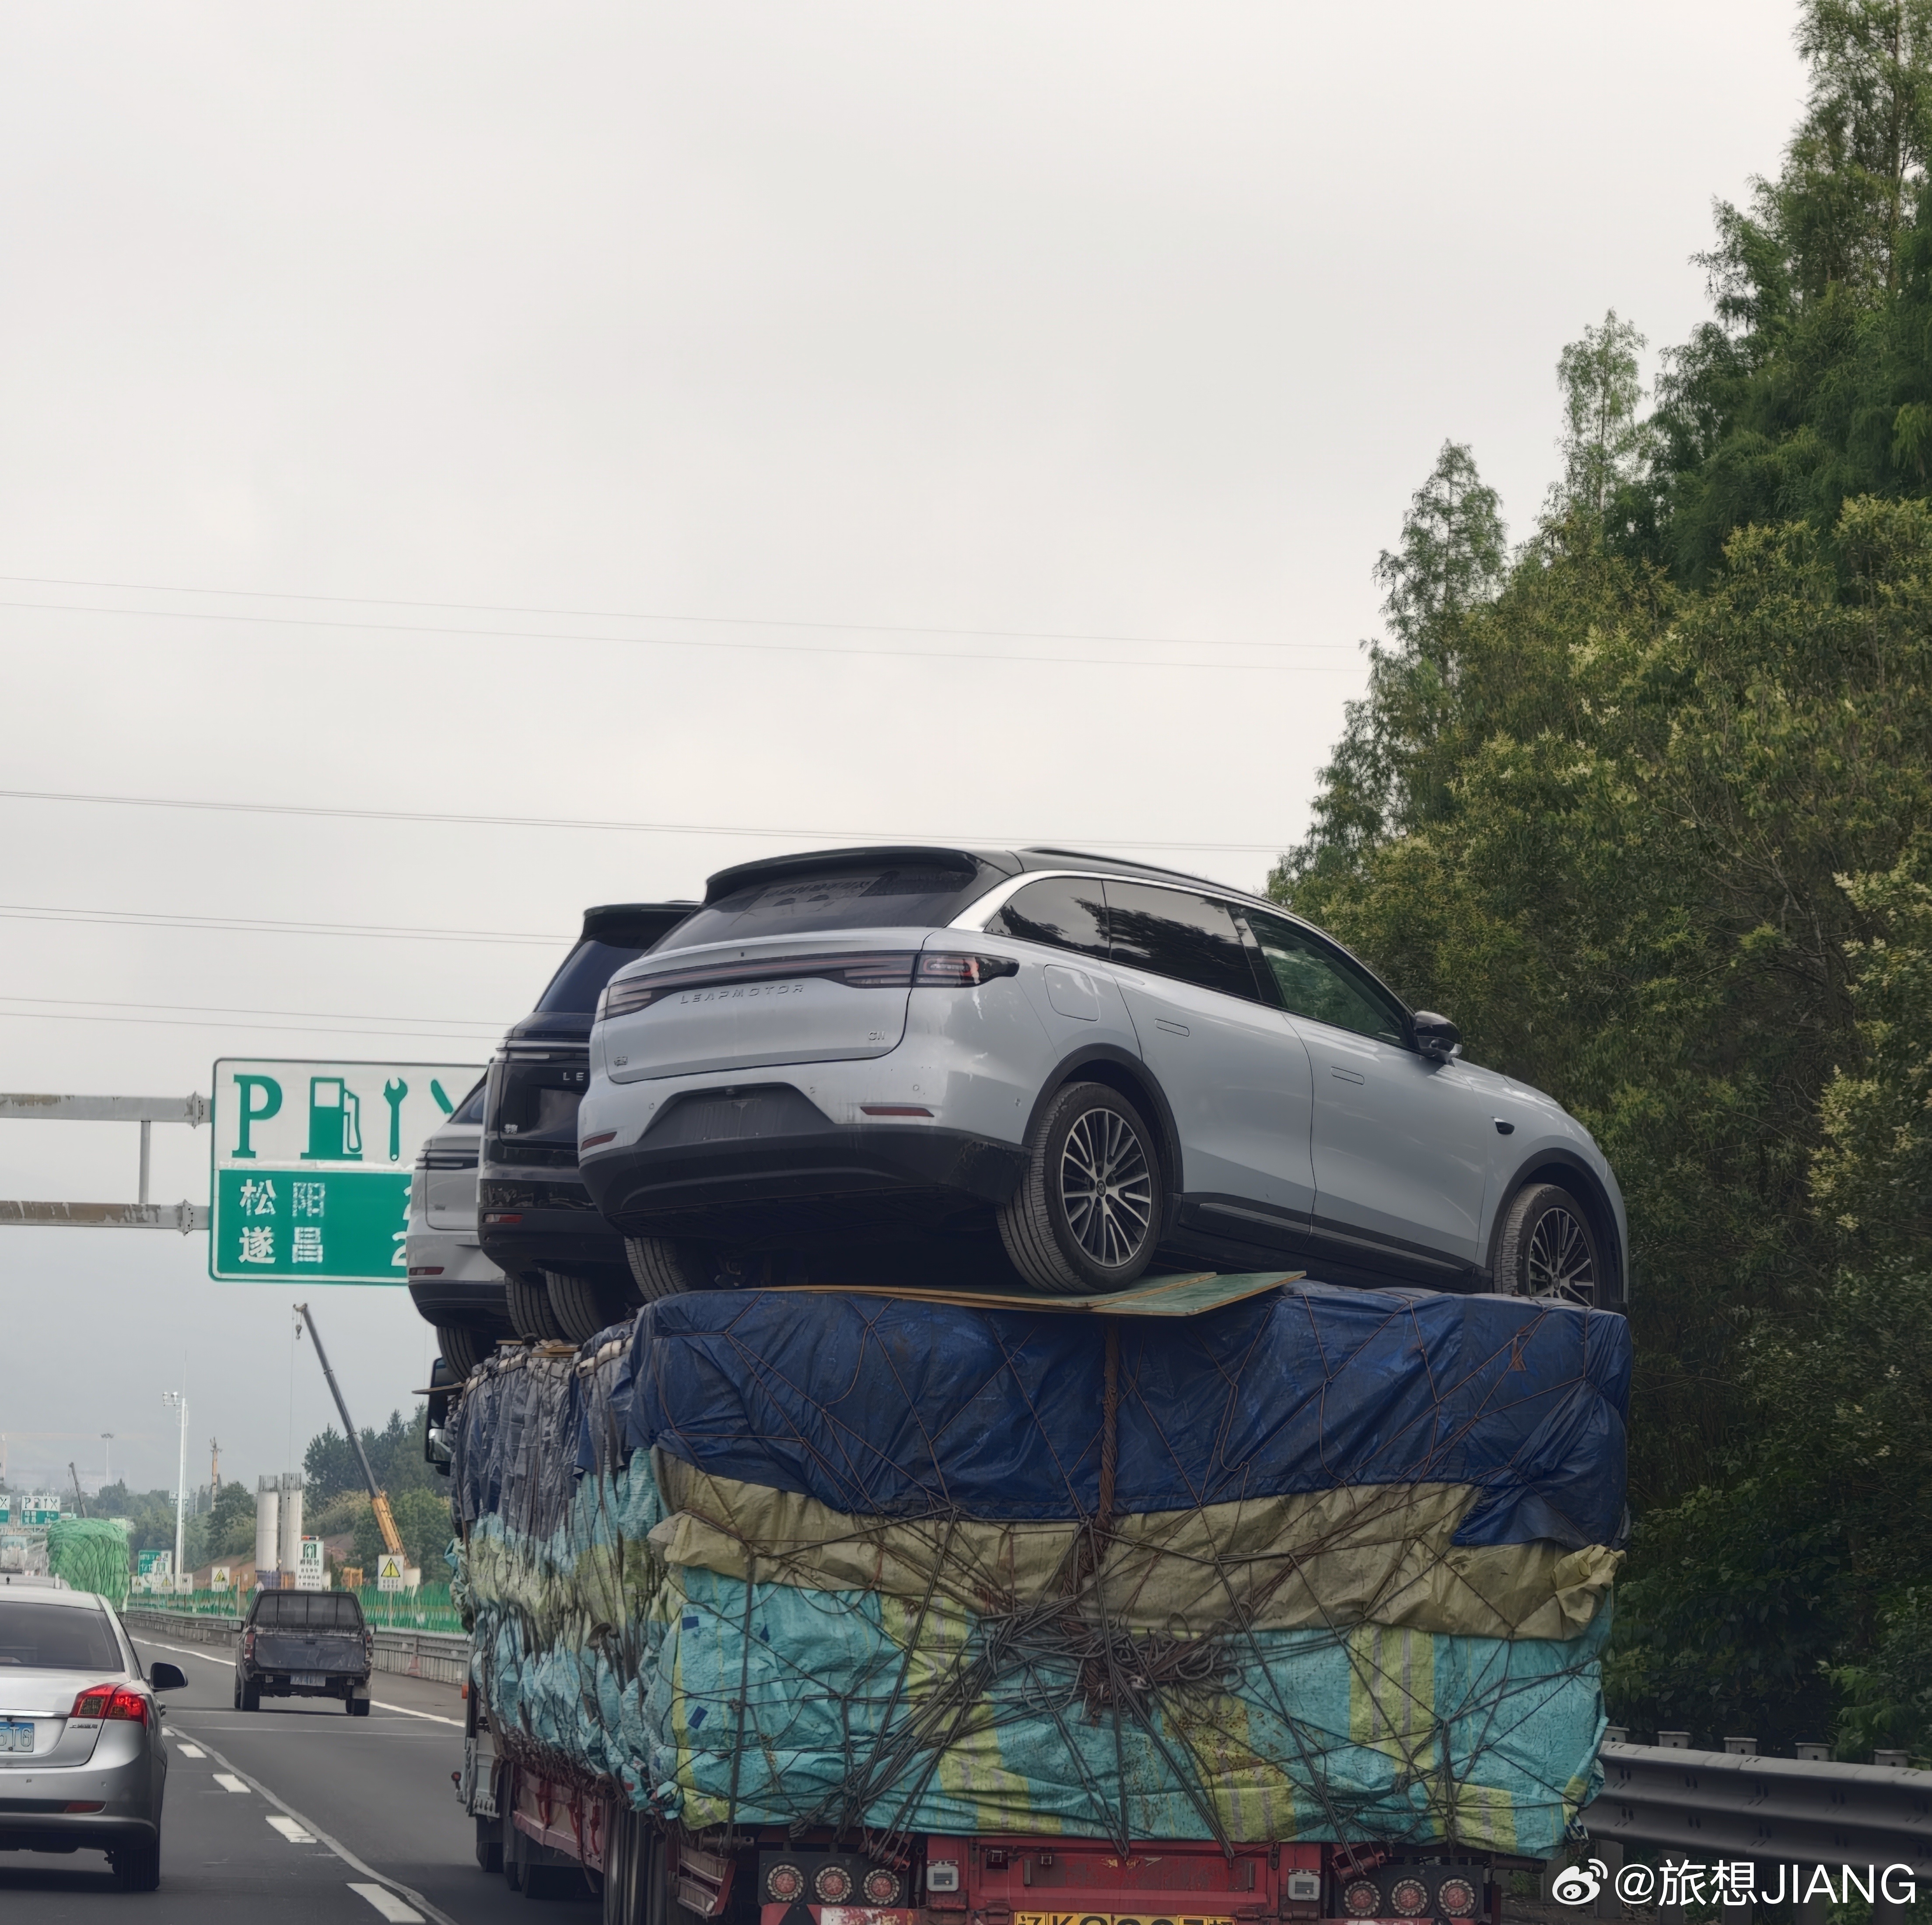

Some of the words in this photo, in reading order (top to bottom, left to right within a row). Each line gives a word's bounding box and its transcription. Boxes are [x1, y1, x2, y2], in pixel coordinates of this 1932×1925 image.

[680, 985, 804, 1004] LEAPMOTOR
[232, 1074, 283, 1158] P
[240, 1179, 325, 1218] 松阳
[238, 1226, 323, 1264] 遂昌
